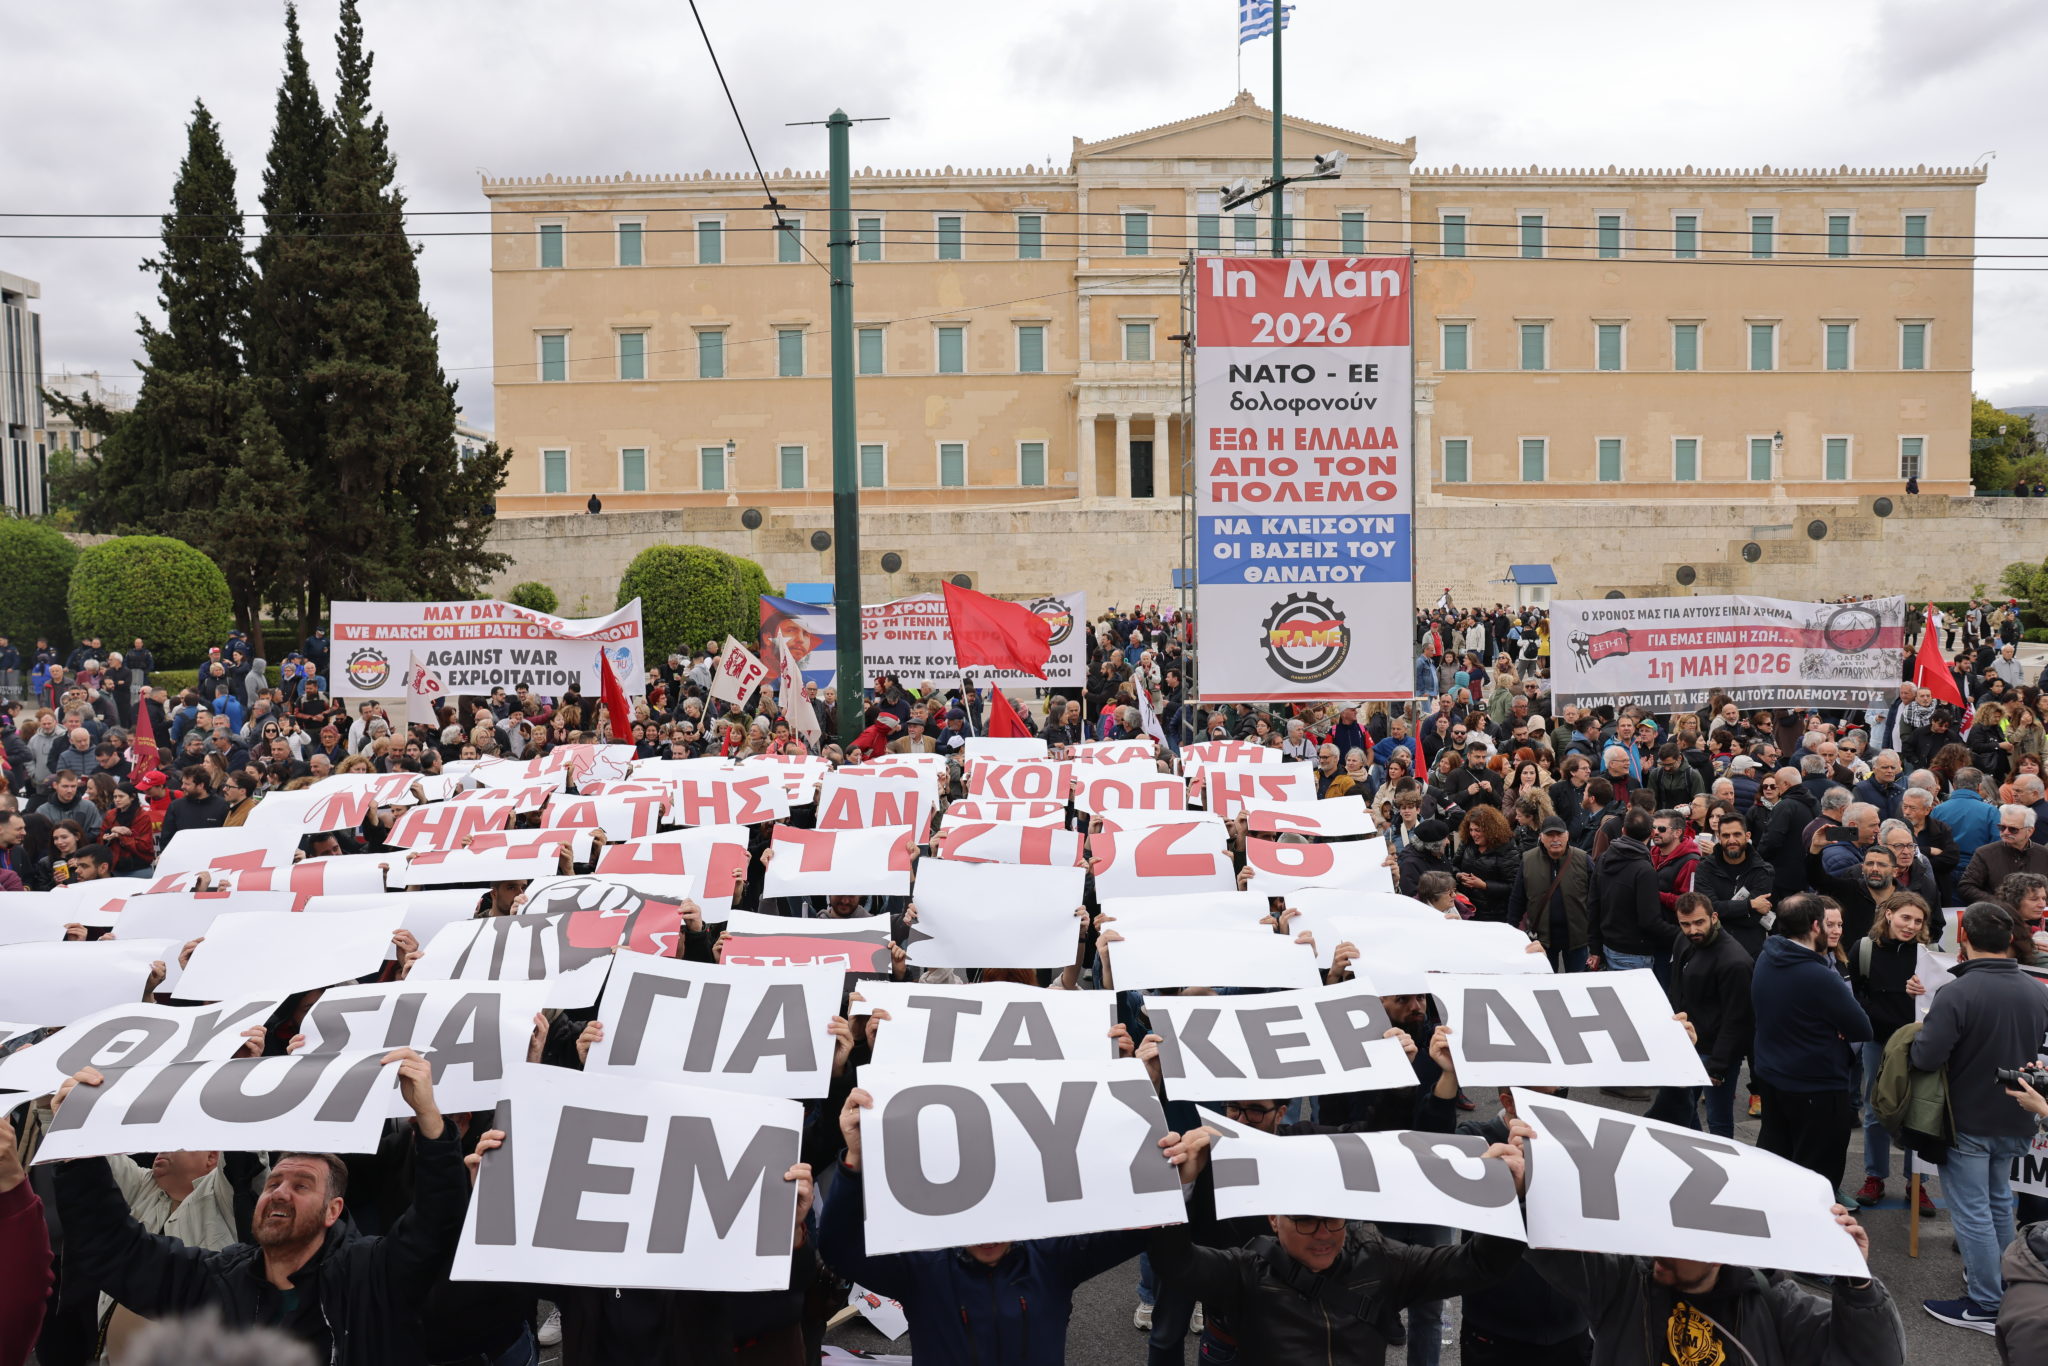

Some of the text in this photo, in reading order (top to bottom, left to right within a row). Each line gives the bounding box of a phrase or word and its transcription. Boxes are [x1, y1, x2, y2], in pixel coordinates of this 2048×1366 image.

[1250, 311, 1352, 344] 2026
[1228, 363, 1316, 384] ΝΑΤΟ
[1348, 363, 1379, 384] ΕΕ
[1229, 390, 1378, 417] δολοφονούν
[1209, 426, 1399, 451] ΕΞΩ Η ΕΛΛΑΔΑ
[1209, 455, 1397, 477] ΑΠΟ ΤΟΝ
[1211, 480, 1398, 503] ΠΟΛΕΜΟ
[1214, 517, 1394, 535] ΝΑ ΚΛΕΙΣΟΥΝ
[1213, 541, 1396, 559] ΟΙ ΒΑΣΕΙΣ ΤΟΥ
[1243, 565, 1366, 583] ΘΑΝΑΤΟΥ
[423, 605, 465, 621] MAY
[471, 603, 505, 620] DAY
[861, 602, 948, 617] 00 ΧΡΟΝΙ
[1581, 605, 1793, 622] Ο ΧΡΟΝΟΣ ΜΑΣ ΓΙΑ ΑΥΤΟΥΣ ΕΙΝΑΙ ΧΡΗΜΑ
[883, 618, 899, 627] ΤΗ
[903, 616, 951, 627] ΓΕΝΝΗΣ
[345, 625, 370, 639] WE
[375, 626, 428, 639] MARCH
[432, 625, 454, 639] ON
[458, 625, 481, 638] THE
[484, 624, 521, 638] PATH
[526, 624, 547, 638] OF
[861, 631, 879, 641] ΟΥ
[884, 630, 938, 641] ΦΙΝΤΕΛ
[1647, 629, 1795, 647] ΓΙΑ ΕΜΑΣ ΕΙΝΑΙ Η ΖΩΗ...
[426, 648, 558, 667] AGAINST WAR
[863, 655, 895, 665] ΠΙΔΑ
[898, 655, 921, 665] ΤΗΣ
[1044, 654, 1073, 664] ΑΟΙ
[929, 670, 961, 679] ΤΩΡΑ
[965, 670, 979, 679] ΟΙ
[1647, 653, 1791, 684] 1η ΜΑΗ 2026
[448, 669, 581, 687] EXPLOITATION
[1576, 695, 1615, 709] ΚΑΜΙΑ
[1617, 693, 1652, 707] ΘΥΣΙΑ
[1653, 693, 1672, 706] ΓΙΑ
[1674, 692, 1689, 705] ΤΑ
[1727, 690, 1746, 702] ΚΑΙ
[1748, 688, 1775, 701] ΤΟΥΣ
[1777, 687, 1848, 702] ΠΟΛΕΜΟΥΣ
[1850, 688, 1885, 702] ΤΟΥΣ
[607, 970, 818, 1074] ΓΙΑ
[906, 994, 1065, 1063] ΤΑ
[1109, 985, 1652, 1081] ΚΕΡΔΗ
